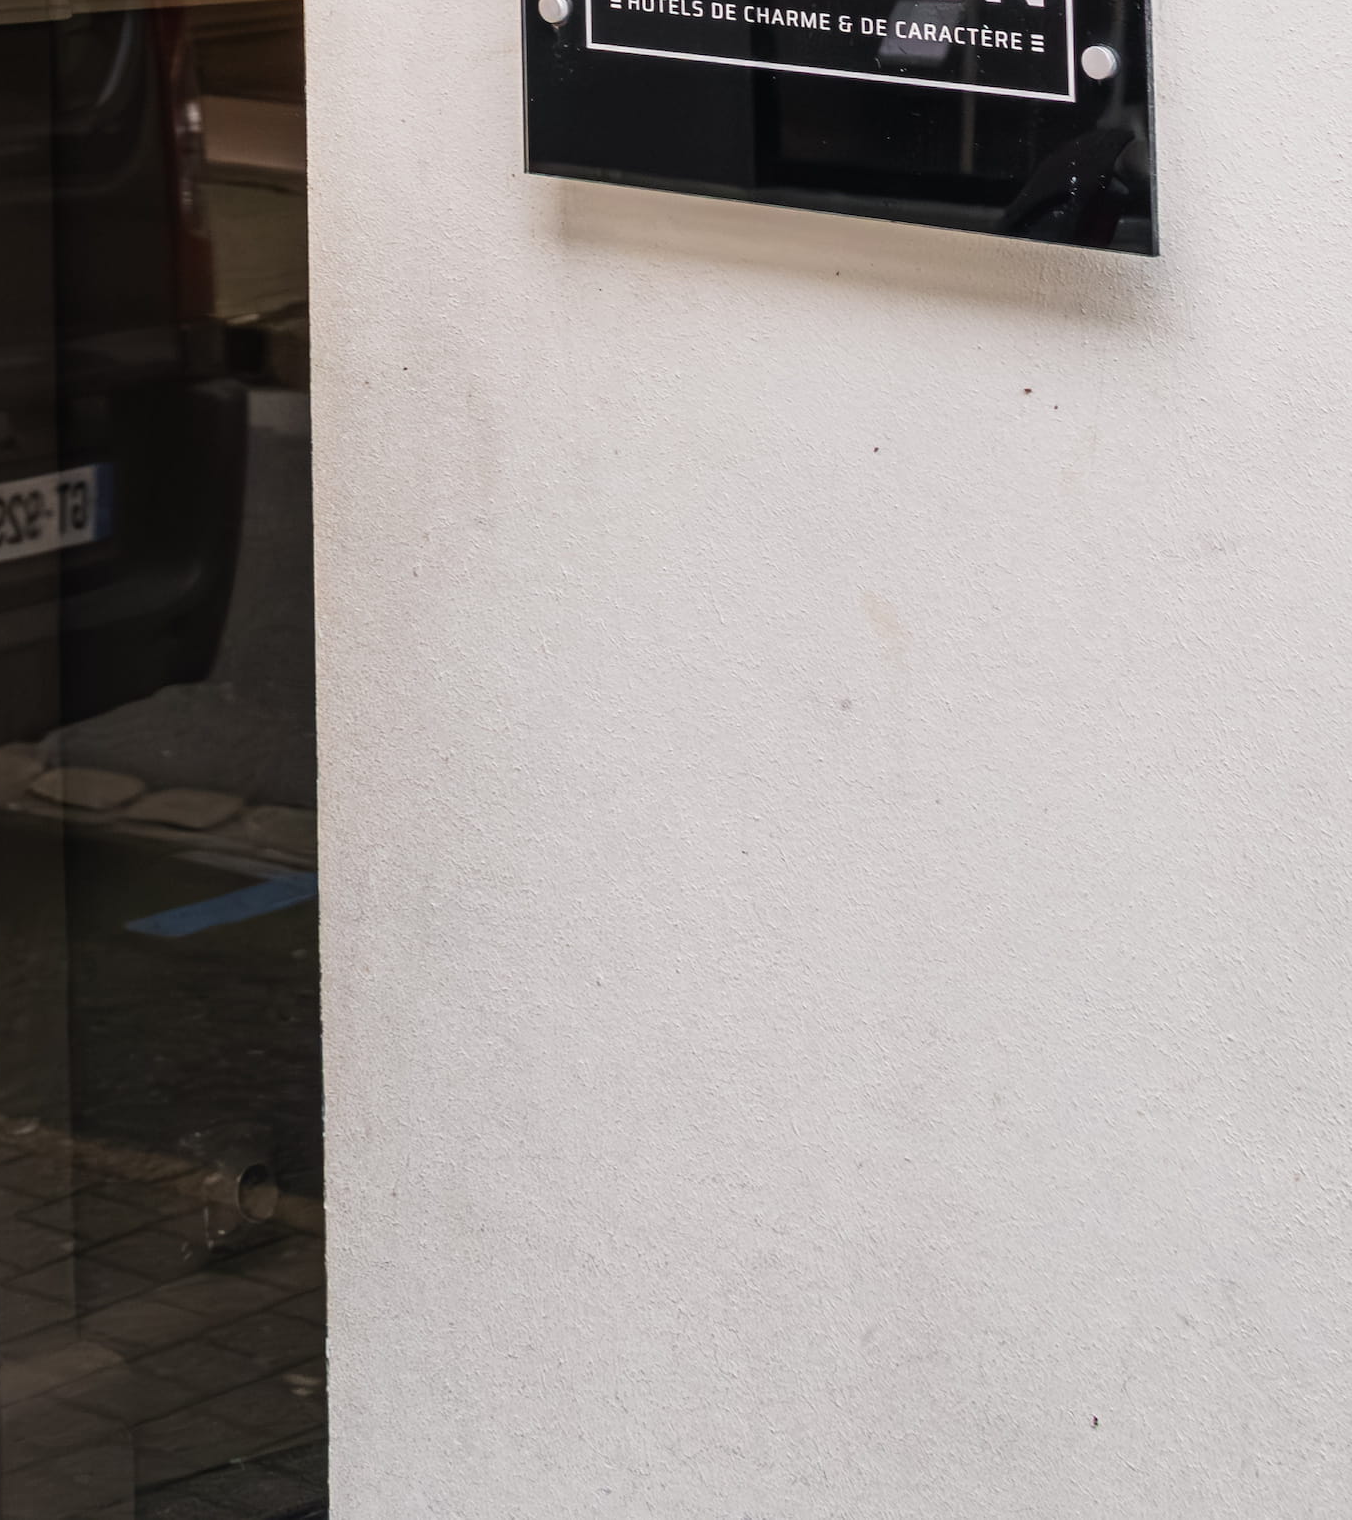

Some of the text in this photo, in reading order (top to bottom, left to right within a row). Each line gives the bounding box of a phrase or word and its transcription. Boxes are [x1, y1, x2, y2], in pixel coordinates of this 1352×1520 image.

[711, 0, 738, 24] DE
[743, 3, 833, 31] CHARME
[838, 11, 854, 35] &
[860, 13, 889, 38] DE
[894, 14, 1025, 52] CARACTÈRE
